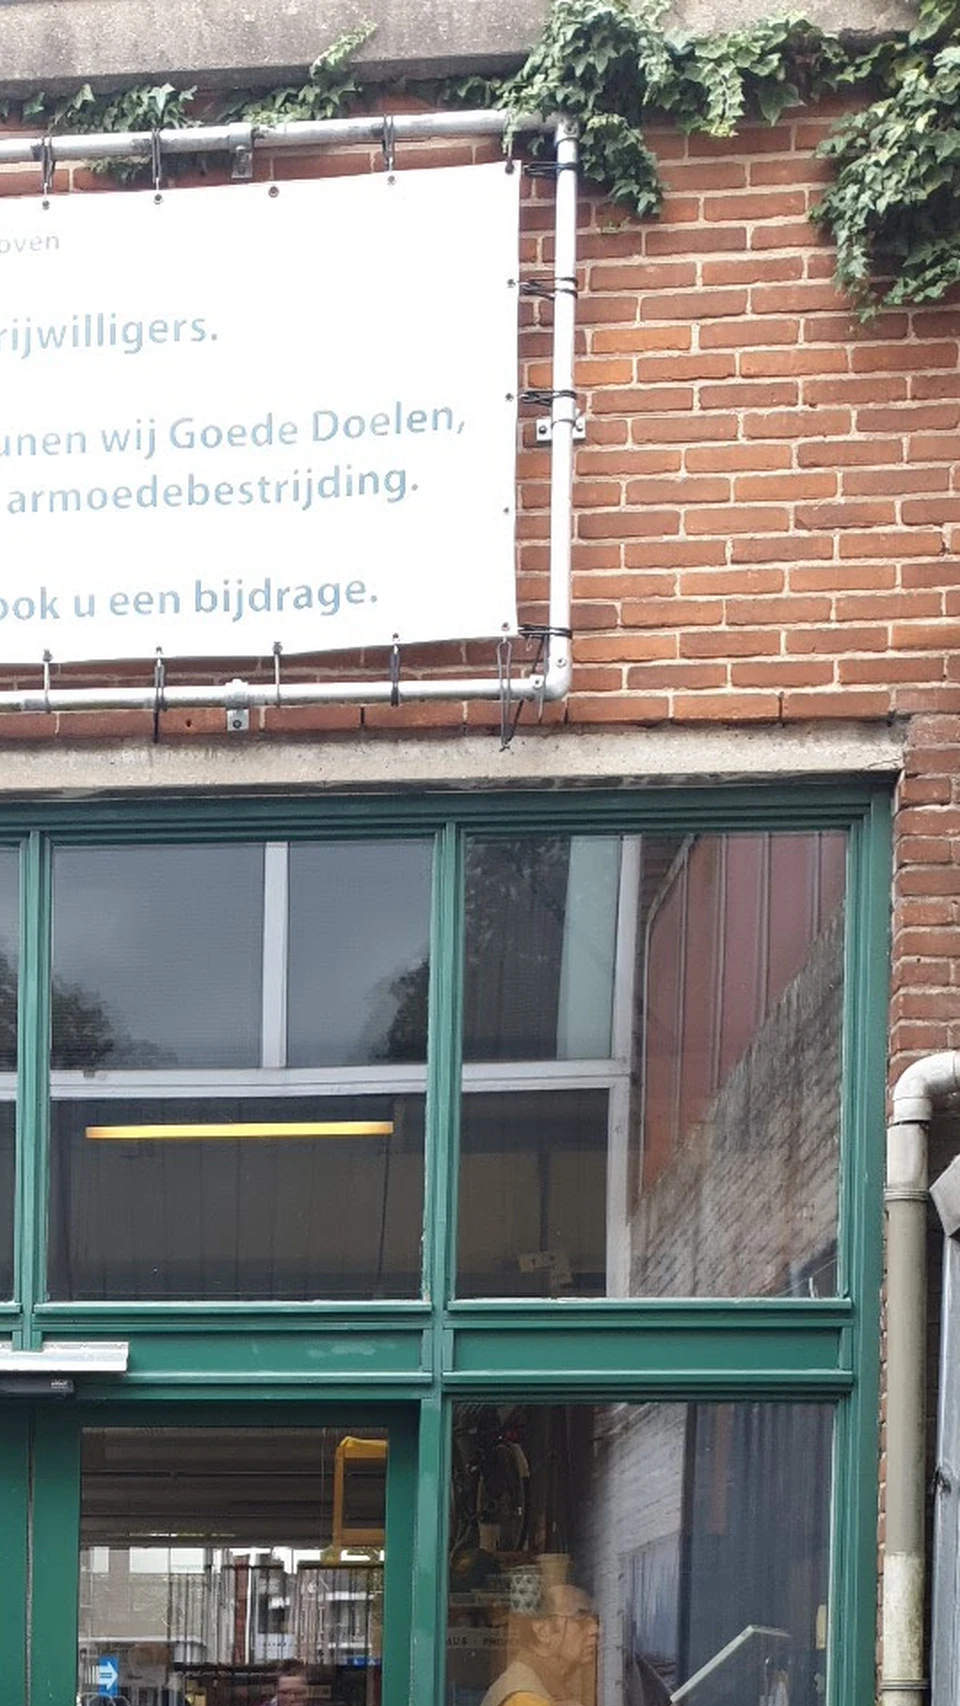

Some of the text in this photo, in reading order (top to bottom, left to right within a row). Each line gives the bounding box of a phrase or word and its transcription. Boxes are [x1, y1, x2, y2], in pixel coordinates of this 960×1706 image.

[100, 418, 157, 460] wij
[169, 412, 299, 450] Goede
[312, 401, 465, 443] Doelen,
[6, 464, 420, 514] armoedebestrijding.
[73, 592, 95, 618] u
[108, 585, 180, 616] een
[194, 577, 378, 623] bijdrage.
